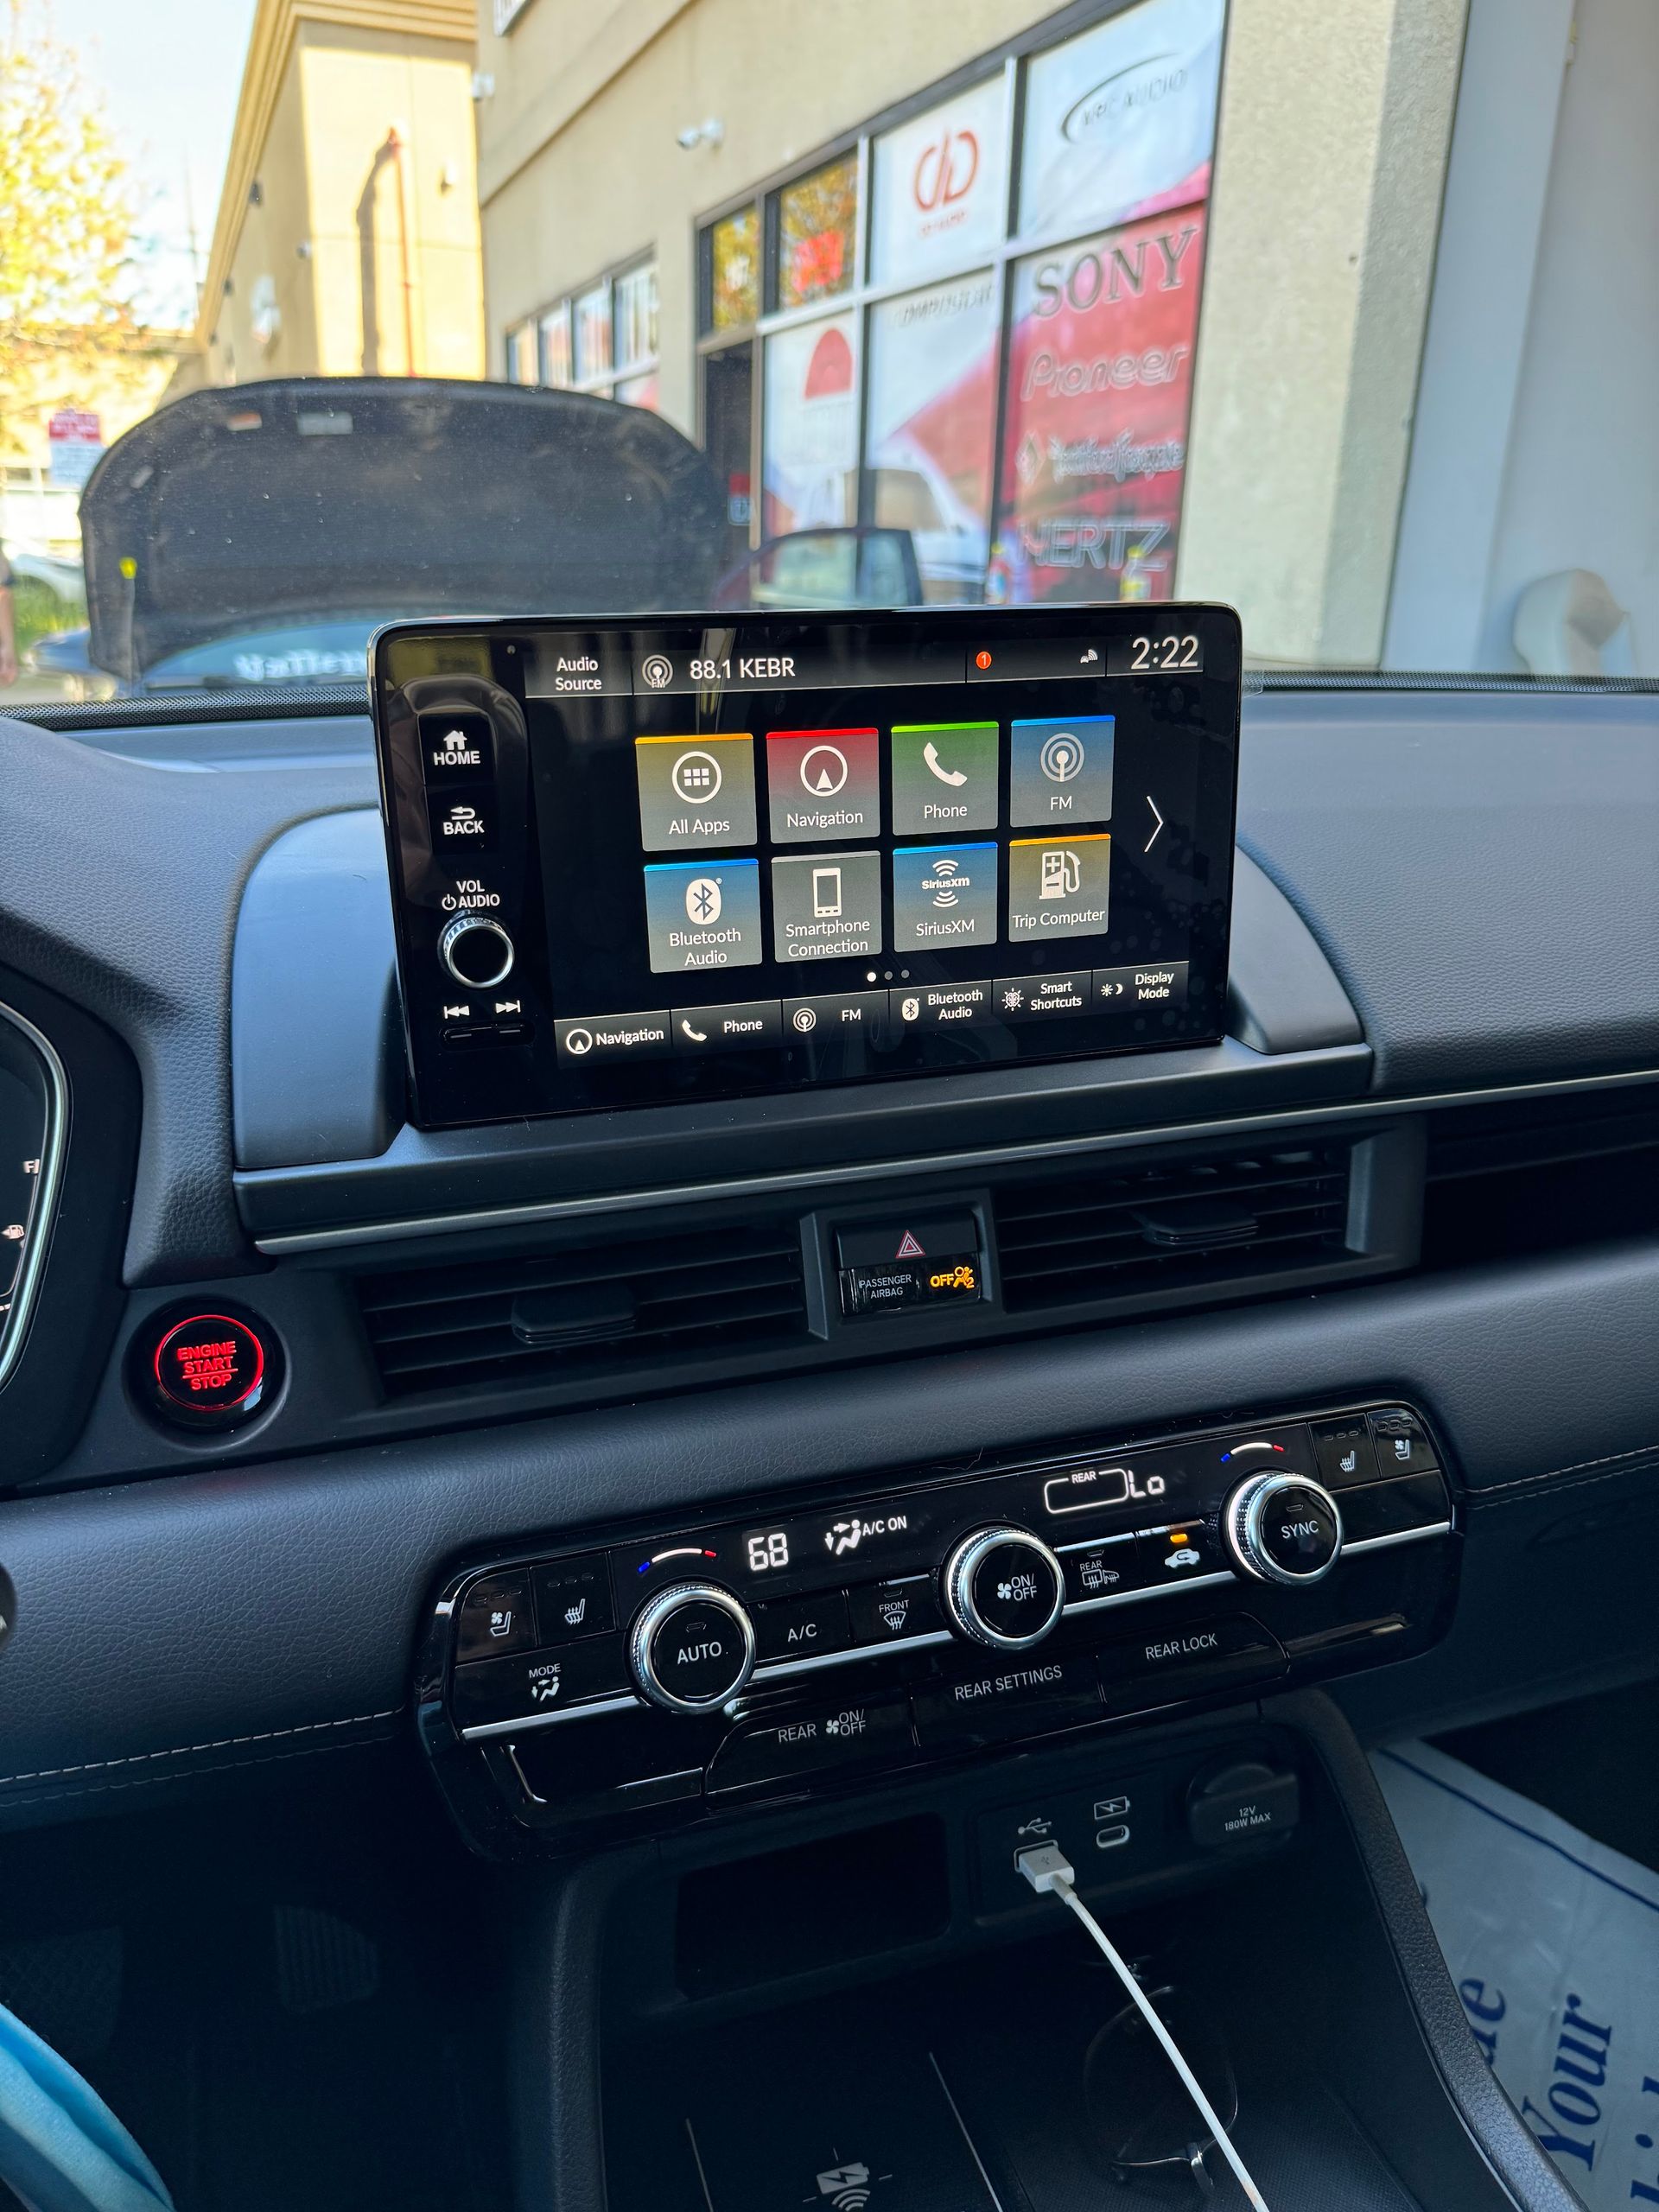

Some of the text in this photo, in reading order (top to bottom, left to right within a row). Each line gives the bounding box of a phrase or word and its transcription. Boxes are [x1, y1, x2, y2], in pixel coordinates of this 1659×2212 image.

[1033, 225, 1198, 318] SONY
[1020, 344, 1189, 402] Pioneer
[1131, 636, 1198, 671] 2:22
[556, 656, 599, 673] Audio
[690, 657, 796, 681] 88.1 KEBR
[556, 677, 602, 691] Source
[433, 750, 480, 766] HOME
[924, 804, 968, 819] Phone
[1050, 796, 1073, 810] FM
[443, 819, 485, 836] BACK
[668, 818, 730, 837] All Apps
[786, 809, 864, 830] Navigation
[456, 880, 485, 893] VOL
[459, 893, 500, 909] AUDIO
[915, 918, 976, 937] SiriusXM
[1012, 908, 1105, 930] Trip Computer
[669, 928, 741, 947] Bluetooth
[785, 919, 870, 941] Smartphone
[787, 939, 868, 958] Connection
[683, 950, 728, 966] Audio
[1040, 980, 1072, 995] Smart
[1135, 970, 1174, 988] Display
[927, 988, 983, 1006] Bluetooth
[1138, 985, 1170, 1000] Mode
[1030, 995, 1083, 1010] Shortcuts
[842, 1008, 861, 1022] FM
[938, 1005, 972, 1020] Audio
[723, 1017, 764, 1033] Phone
[595, 1027, 664, 1046] Navigation
[860, 1274, 912, 1289] PASSENGER
[930, 1273, 955, 1288] OFF
[870, 1287, 904, 1299] AIRBAG
[177, 1341, 237, 1361] ENGINE
[184, 1356, 233, 1374] START
[190, 1373, 232, 1390] STOP
[1071, 1471, 1096, 1484] REAR
[1128, 1471, 1165, 1498] Lo
[862, 1515, 907, 1536] A/C ON
[1281, 1520, 1319, 1540] SYNC
[747, 1533, 789, 1571] 68
[1079, 1560, 1103, 1572] REAR
[1011, 1573, 1035, 1588] ON/
[1014, 1586, 1037, 1601] OFF
[879, 1599, 910, 1614] FRONT
[787, 1624, 817, 1642] A/C
[677, 1642, 722, 1665] AUTO
[1145, 1633, 1218, 1661] REAR LOCK
[529, 1663, 562, 1679] MODE
[955, 1664, 1063, 1701] REAR SETTINGS
[839, 1708, 865, 1725] ON/
[778, 1723, 817, 1744] REAR
[840, 1720, 866, 1736] OFF
[1238, 1805, 1256, 1818] 12V
[1224, 1812, 1271, 1832] 180W MAX
[1522, 1993, 1612, 2171] Your
